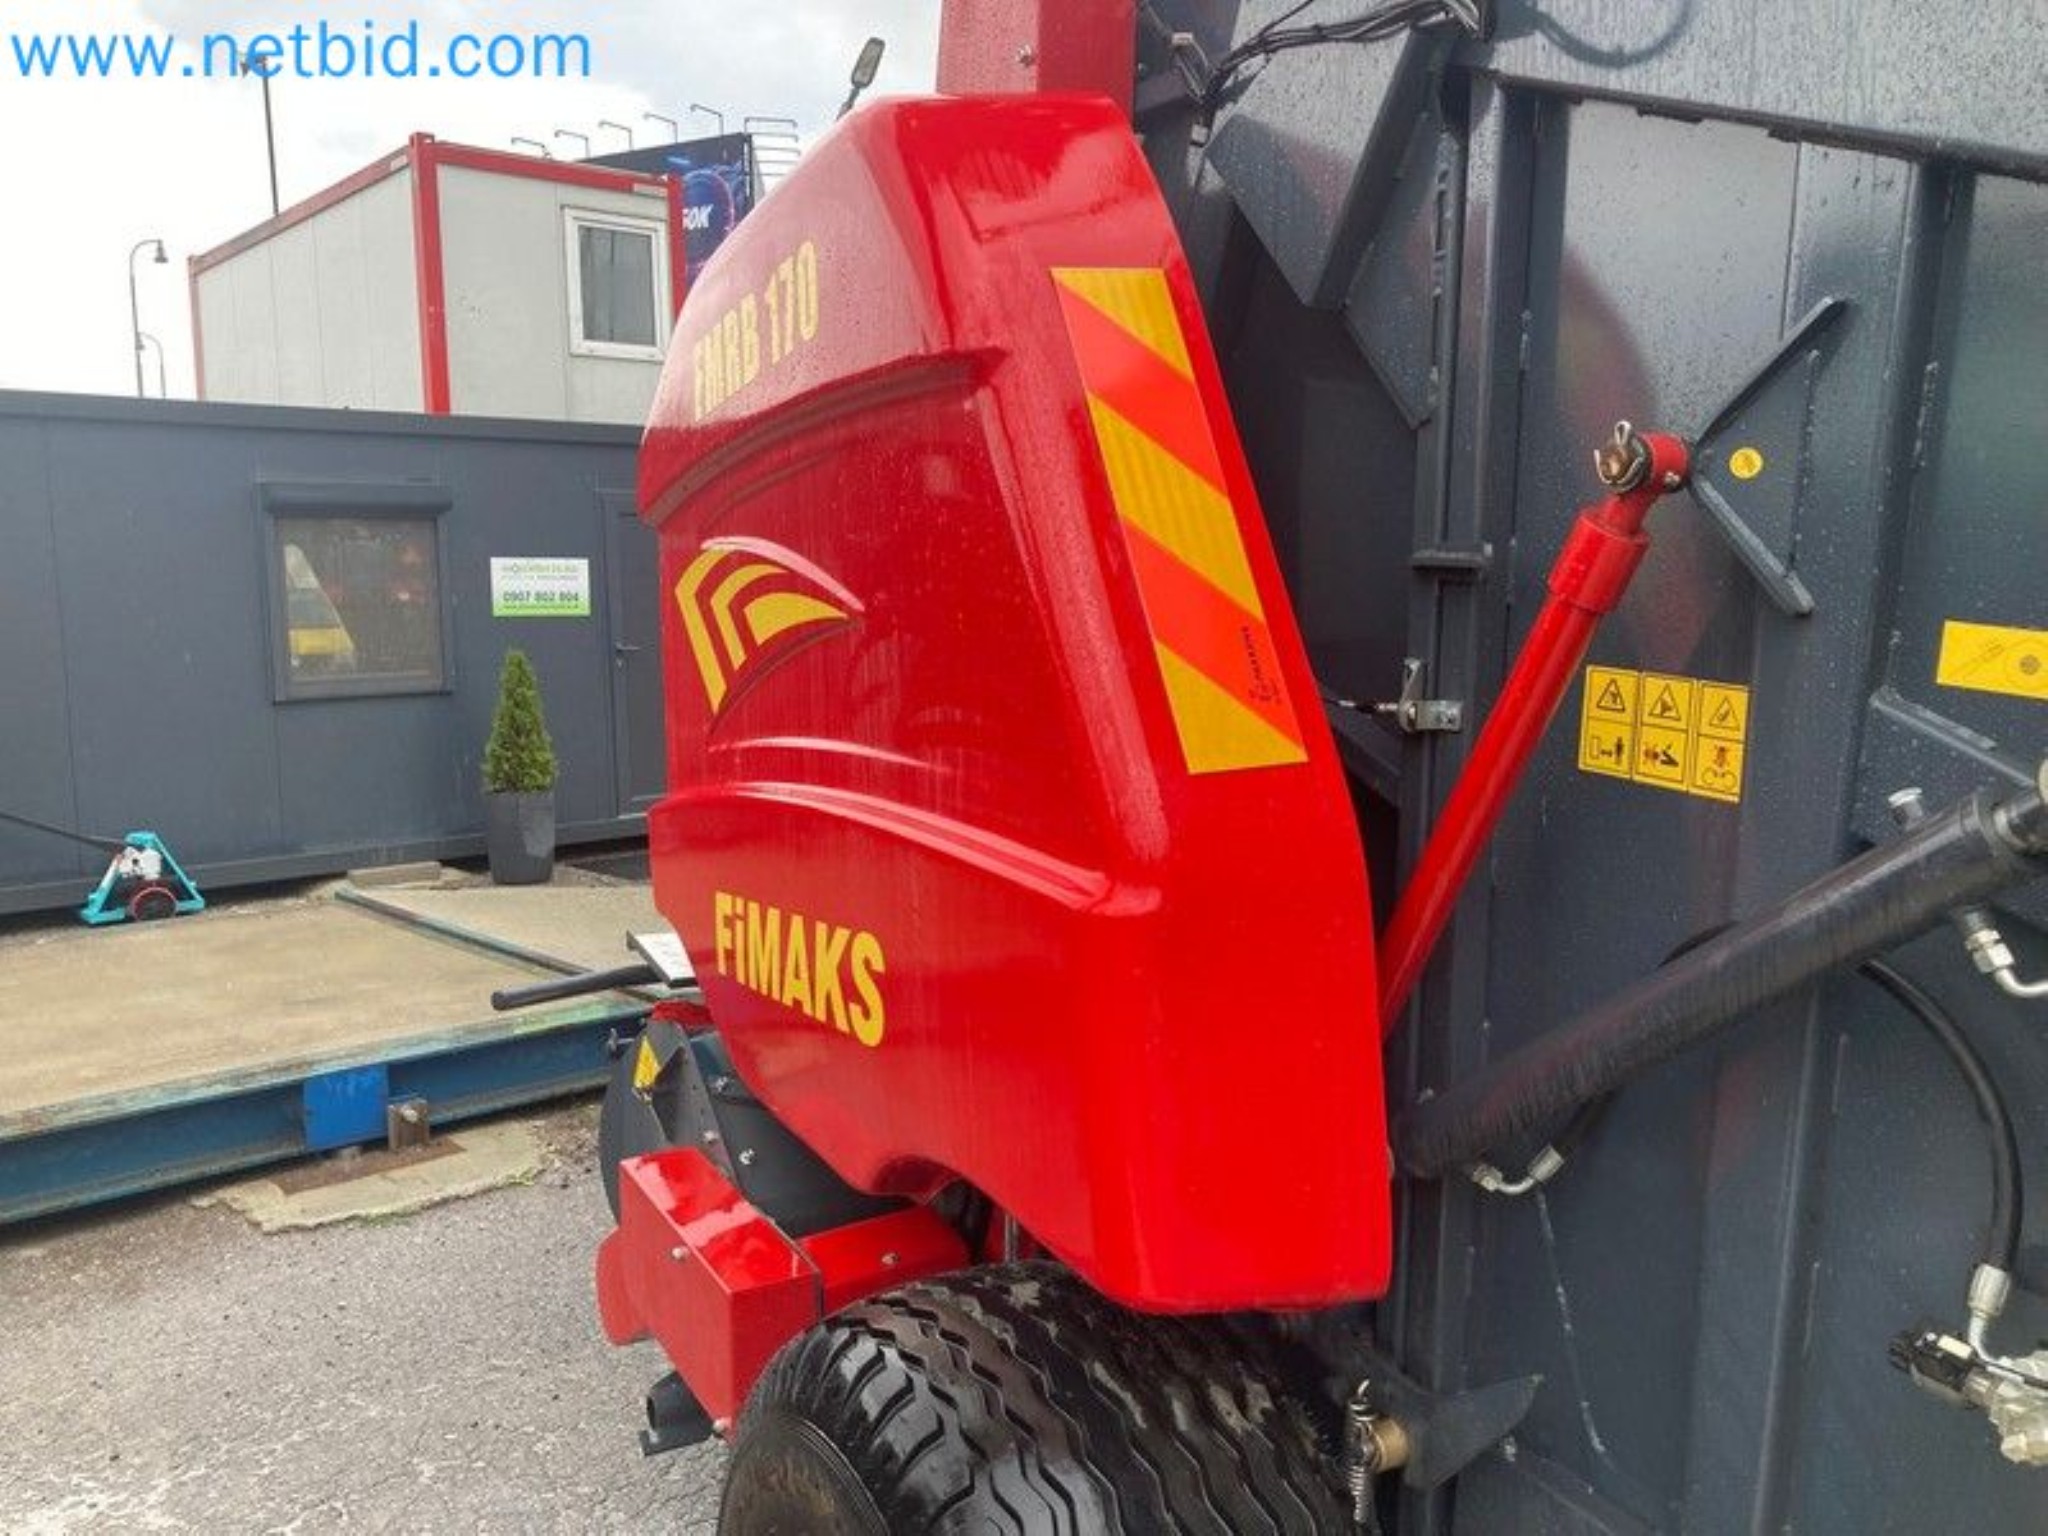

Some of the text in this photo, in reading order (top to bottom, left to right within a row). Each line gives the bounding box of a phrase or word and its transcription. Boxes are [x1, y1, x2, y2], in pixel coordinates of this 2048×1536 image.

[694, 240, 818, 422] FMRB 170
[715, 890, 886, 1048] FiMAKS
